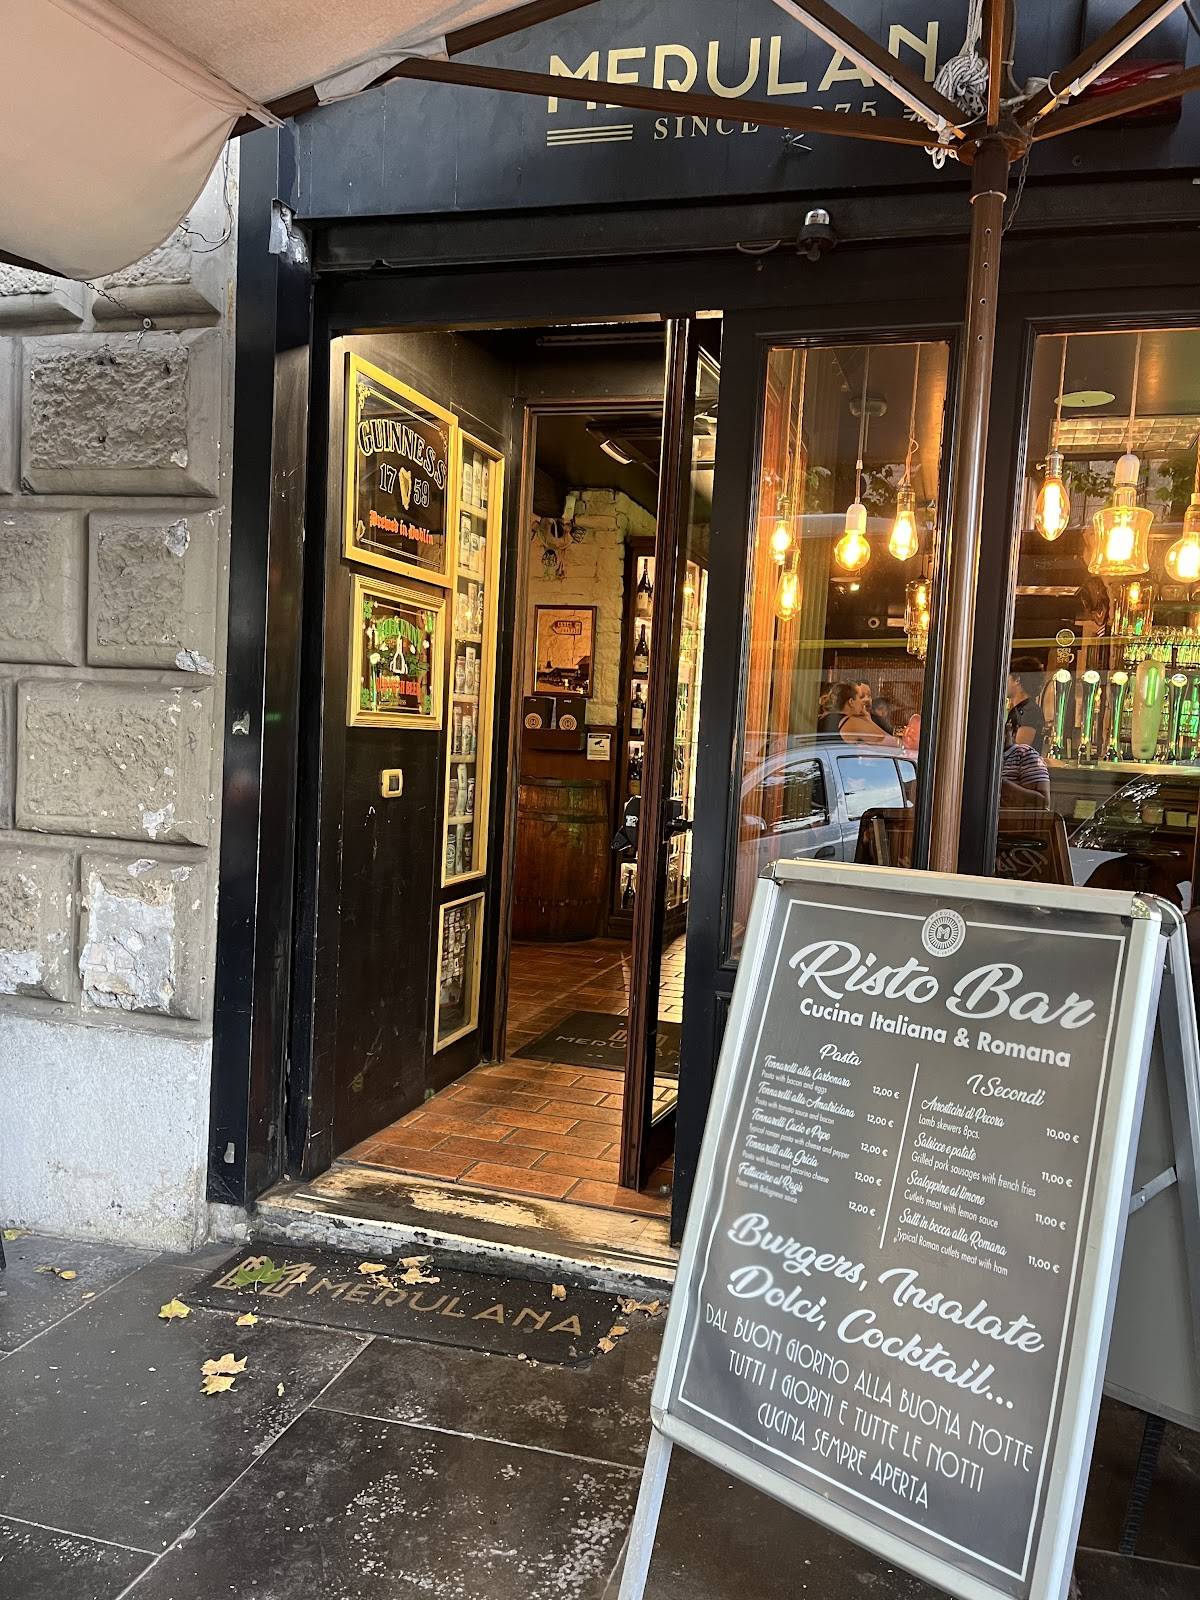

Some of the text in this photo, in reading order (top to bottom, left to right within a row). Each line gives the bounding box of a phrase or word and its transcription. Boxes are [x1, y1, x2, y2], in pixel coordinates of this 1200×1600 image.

[547, 21, 939, 114] MERULAN
[653, 114, 760, 141] SINCE
[357, 418, 447, 491] GUINNESS
[379, 463, 430, 508] 17 59
[788, 940, 1096, 1029] Risto Bar
[799, 997, 1071, 1068] Cucina Italiana & Romana
[819, 1043, 863, 1066] Pasta
[785, 1075, 803, 1087] bacon
[802, 1081, 815, 1091] and
[814, 1085, 828, 1095] eggs
[796, 1065, 813, 1078] alla
[811, 1067, 852, 1088] Carbonara
[872, 1085, 900, 1100] 12,00 €
[980, 1076, 1046, 1106] Secondi
[805, 1095, 856, 1118] Amatriciana
[974, 1107, 1005, 1128] Pecora
[784, 1117, 806, 1134] Cacio
[810, 1124, 831, 1143] Pepe
[866, 1113, 895, 1128] 12,00 €
[918, 1113, 980, 1140] Lamb skewers 8pcs.
[1046, 1127, 1080, 1144] 10,00 €
[792, 1149, 819, 1168] Gricia
[821, 1145, 833, 1155] and
[860, 1142, 889, 1157] 12,00 €
[854, 1171, 883, 1187] 12,00 €
[911, 1150, 1037, 1197] Grilled pork sausages with french fries
[1041, 1171, 1073, 1188] 11,00 €
[906, 1169, 986, 1206] Scaloppine al limone
[848, 1200, 876, 1217] 12,00 €
[903, 1188, 999, 1229] Cutlets meat with lemon sauce
[1035, 1213, 1067, 1231] 11,00 €
[928, 1217, 952, 1237] bocca
[951, 1227, 970, 1243] alla
[969, 1230, 1008, 1257] Romana
[896, 1227, 1008, 1276] Typical Roman cutlets meat with ham
[1028, 1255, 1060, 1274] 11,00 €
[727, 1212, 1045, 1353] Burgers, Insalate
[306, 1279, 583, 1337] MERULANA
[727, 1265, 1014, 1409] Dolci, Cocktail...
[706, 1302, 1034, 1472] DAL BUON GIORNO ALLA BUONA NOTTE
[729, 1349, 984, 1493] TUTTI I GIORNI E TUTTE LE NOTTI
[757, 1402, 928, 1509] CUCINA SEMPRE APERTA
